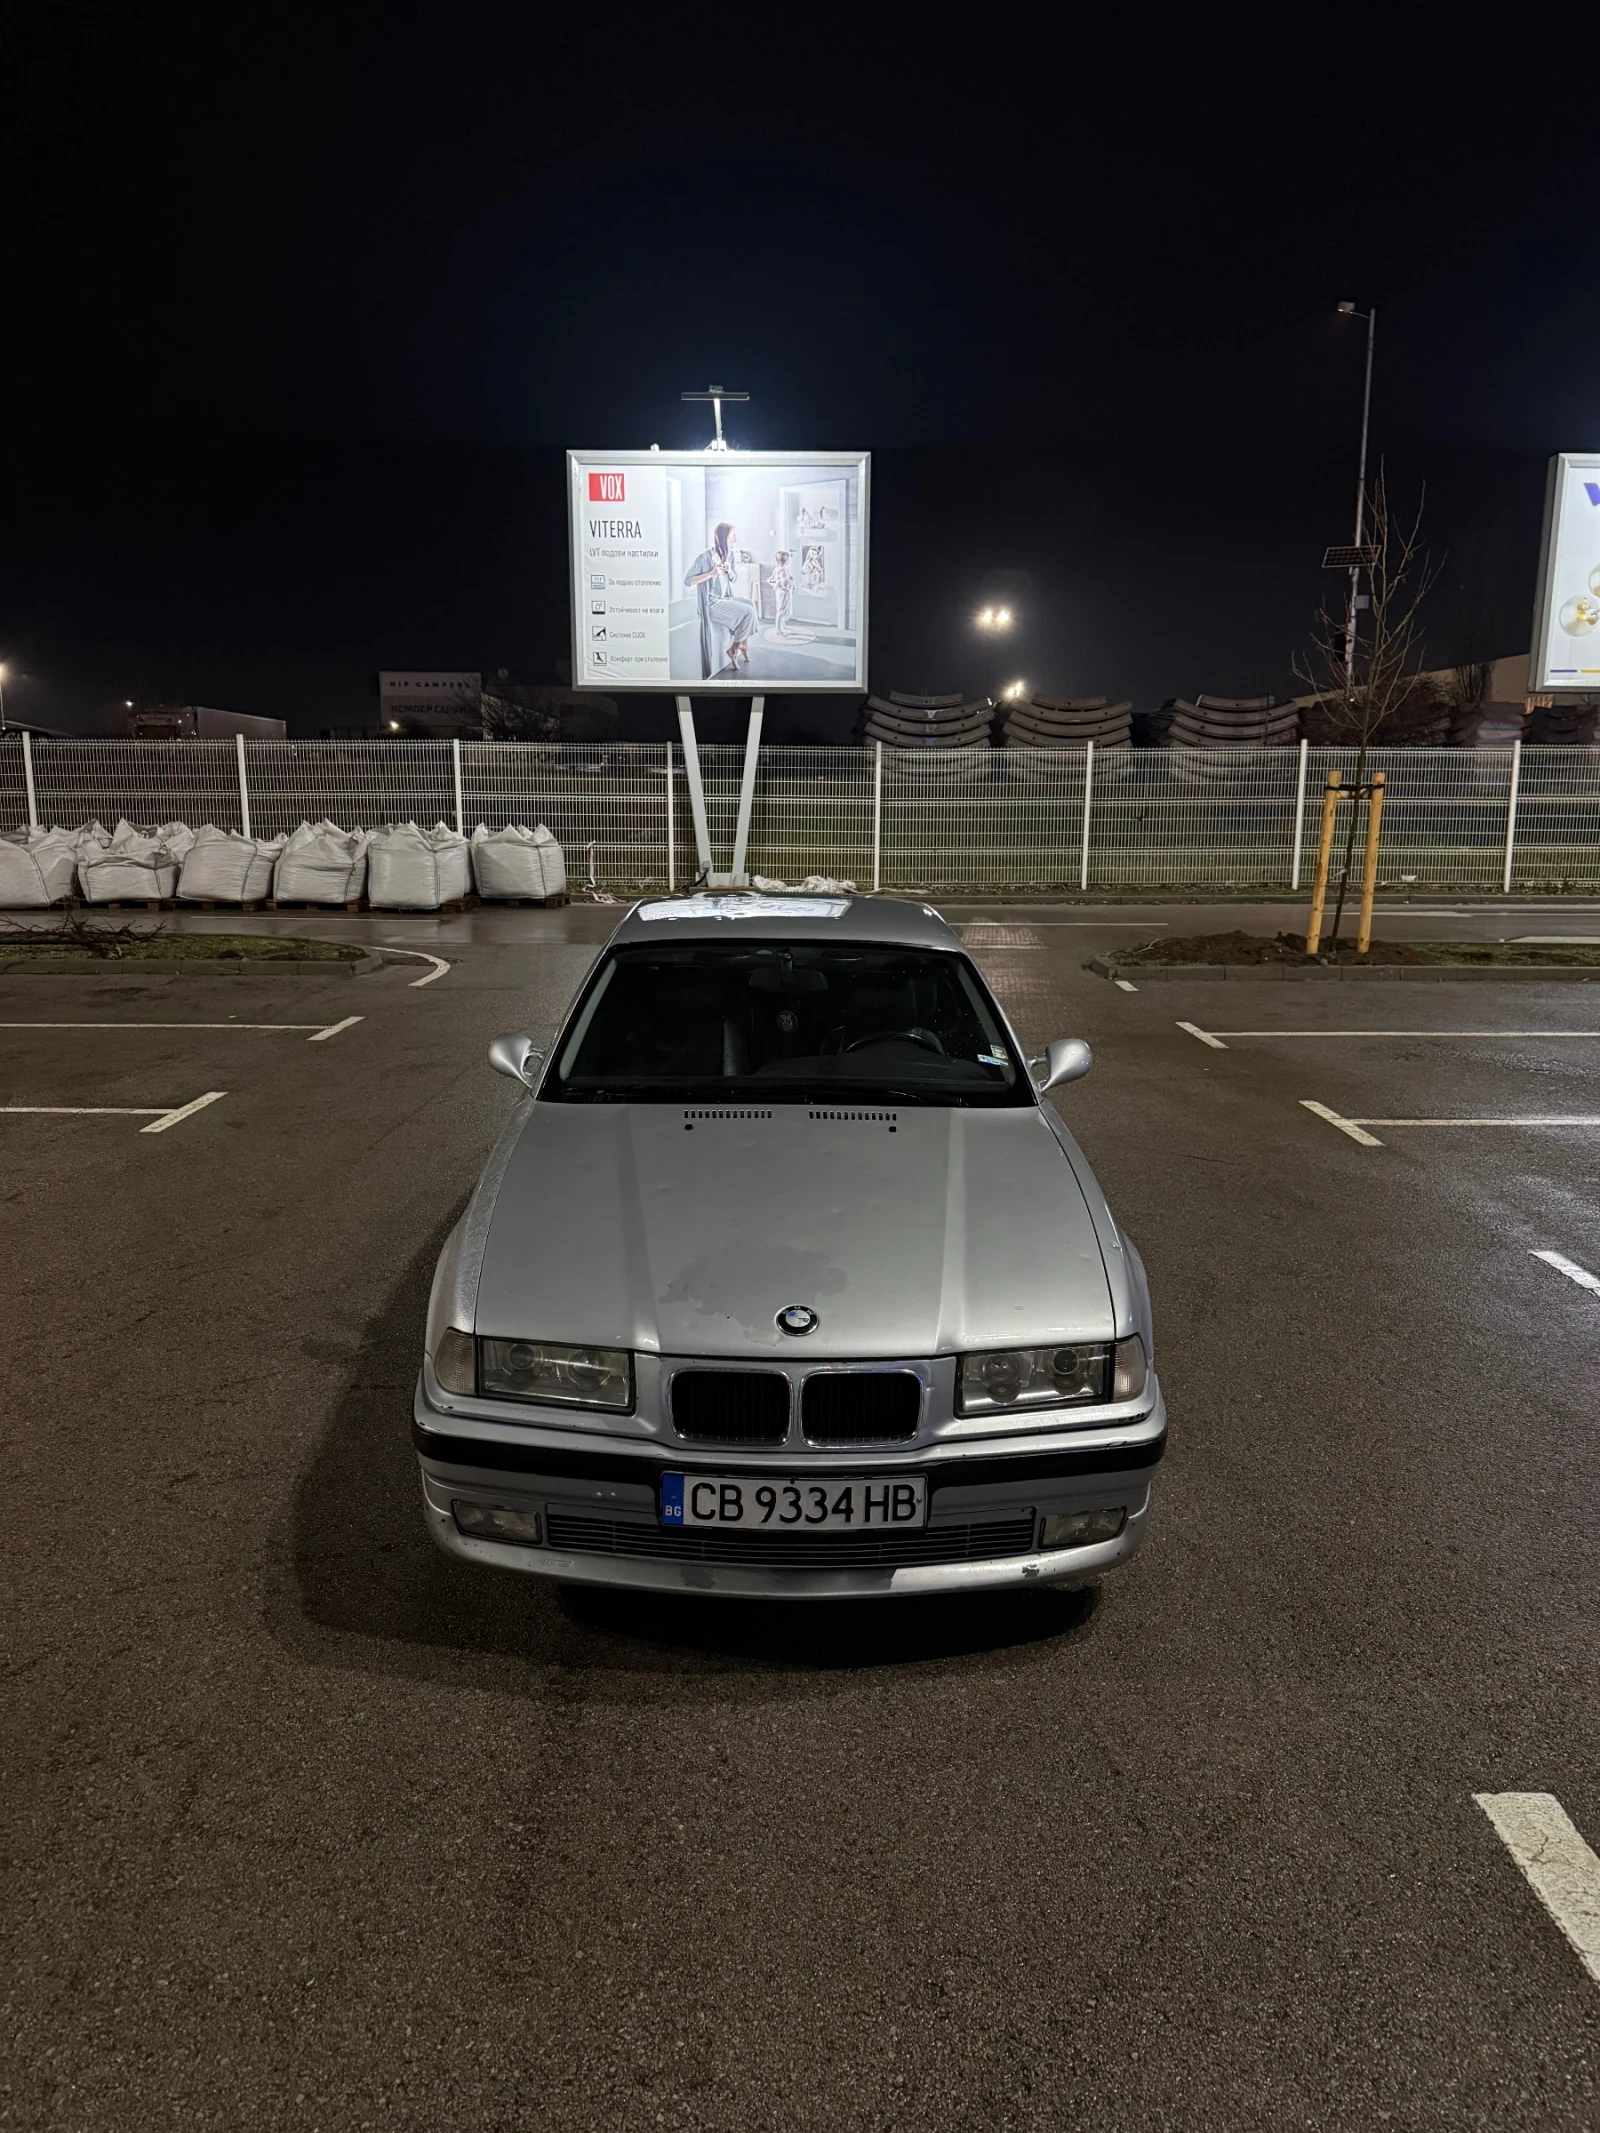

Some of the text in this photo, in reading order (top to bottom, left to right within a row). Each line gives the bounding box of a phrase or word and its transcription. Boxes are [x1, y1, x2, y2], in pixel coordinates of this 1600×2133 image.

[600, 475, 623, 500] VOX
[589, 520, 642, 538] VITERRA
[589, 548, 600, 557] LVT
[602, 549, 626, 558] подови
[665, 1505, 682, 1517] BG
[691, 1483, 917, 1524] CB 9334 HB
